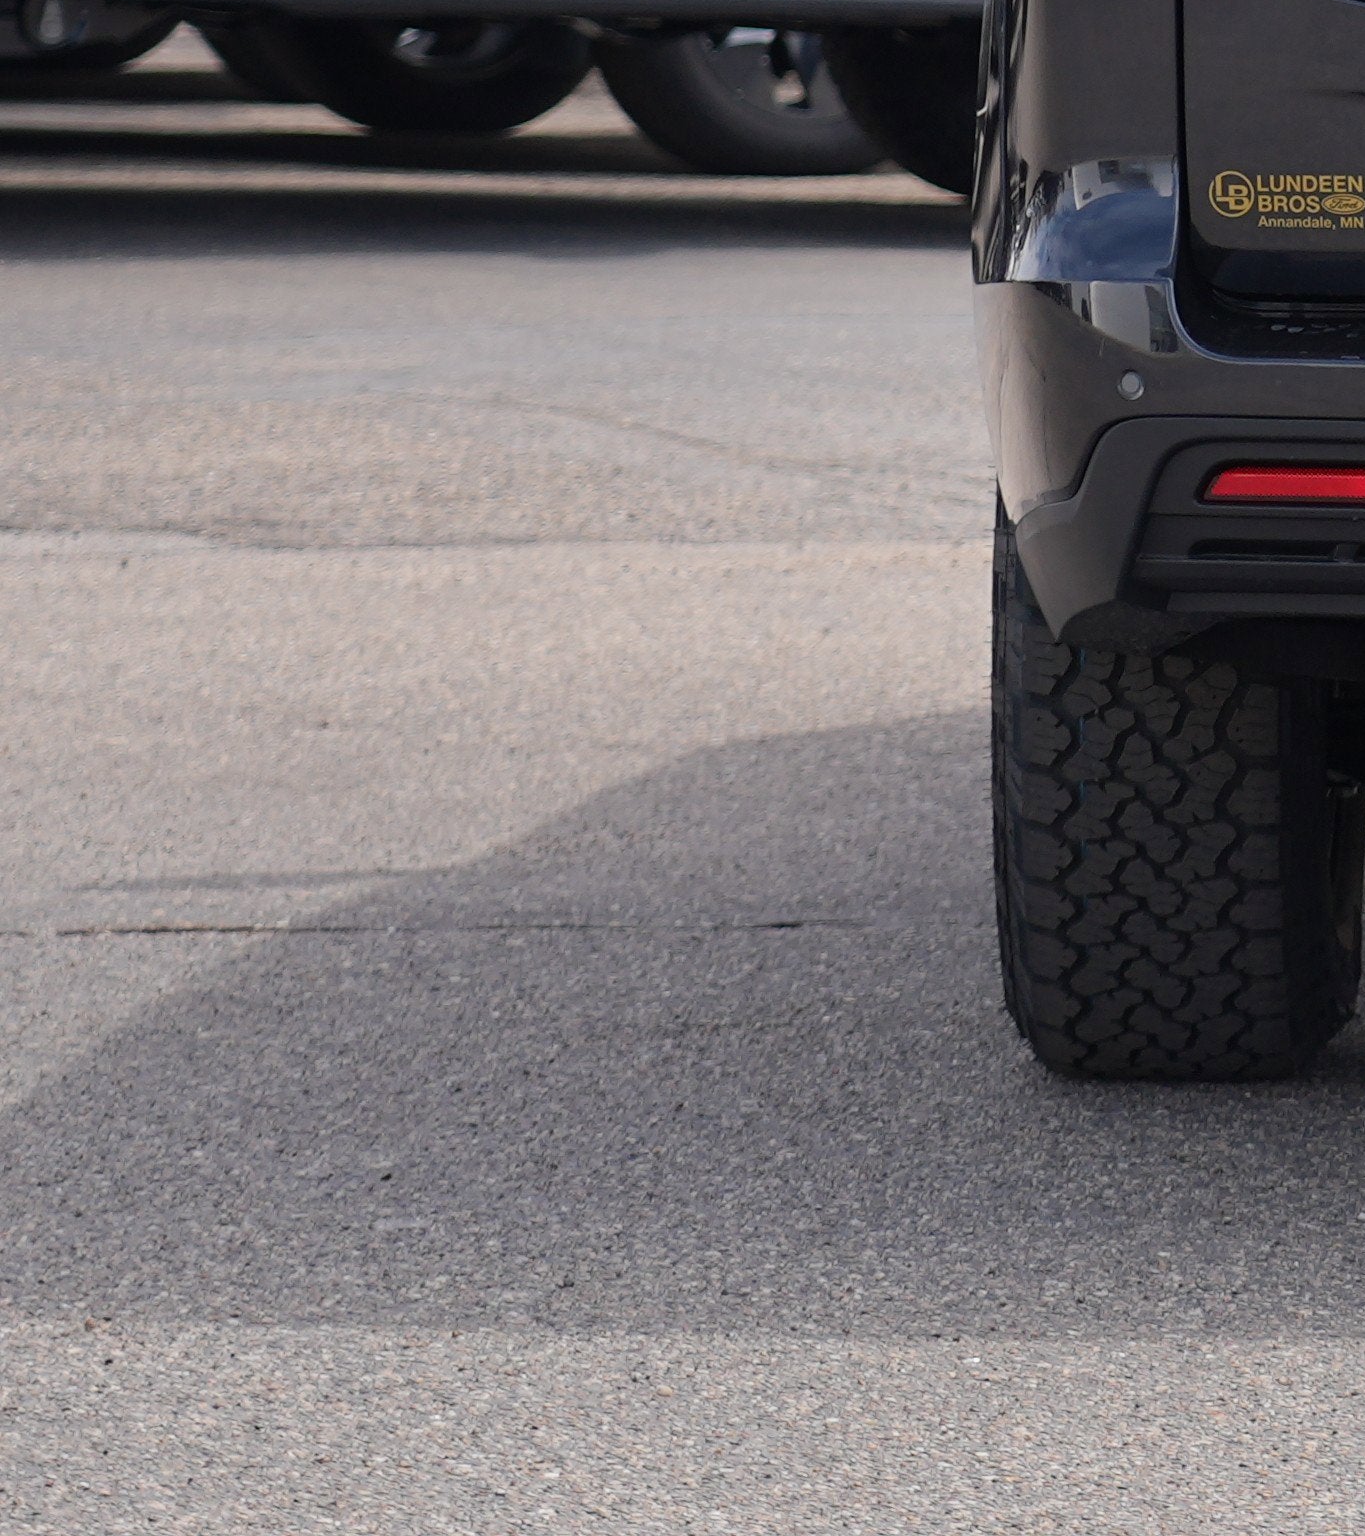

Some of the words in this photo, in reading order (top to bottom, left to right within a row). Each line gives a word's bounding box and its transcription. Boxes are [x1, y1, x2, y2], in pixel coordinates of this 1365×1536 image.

[1256, 175, 1363, 193] LUNDEEN
[1257, 195, 1321, 213] BROS
[1258, 215, 1336, 230] Annandale,
[1340, 217, 1364, 228] MN
